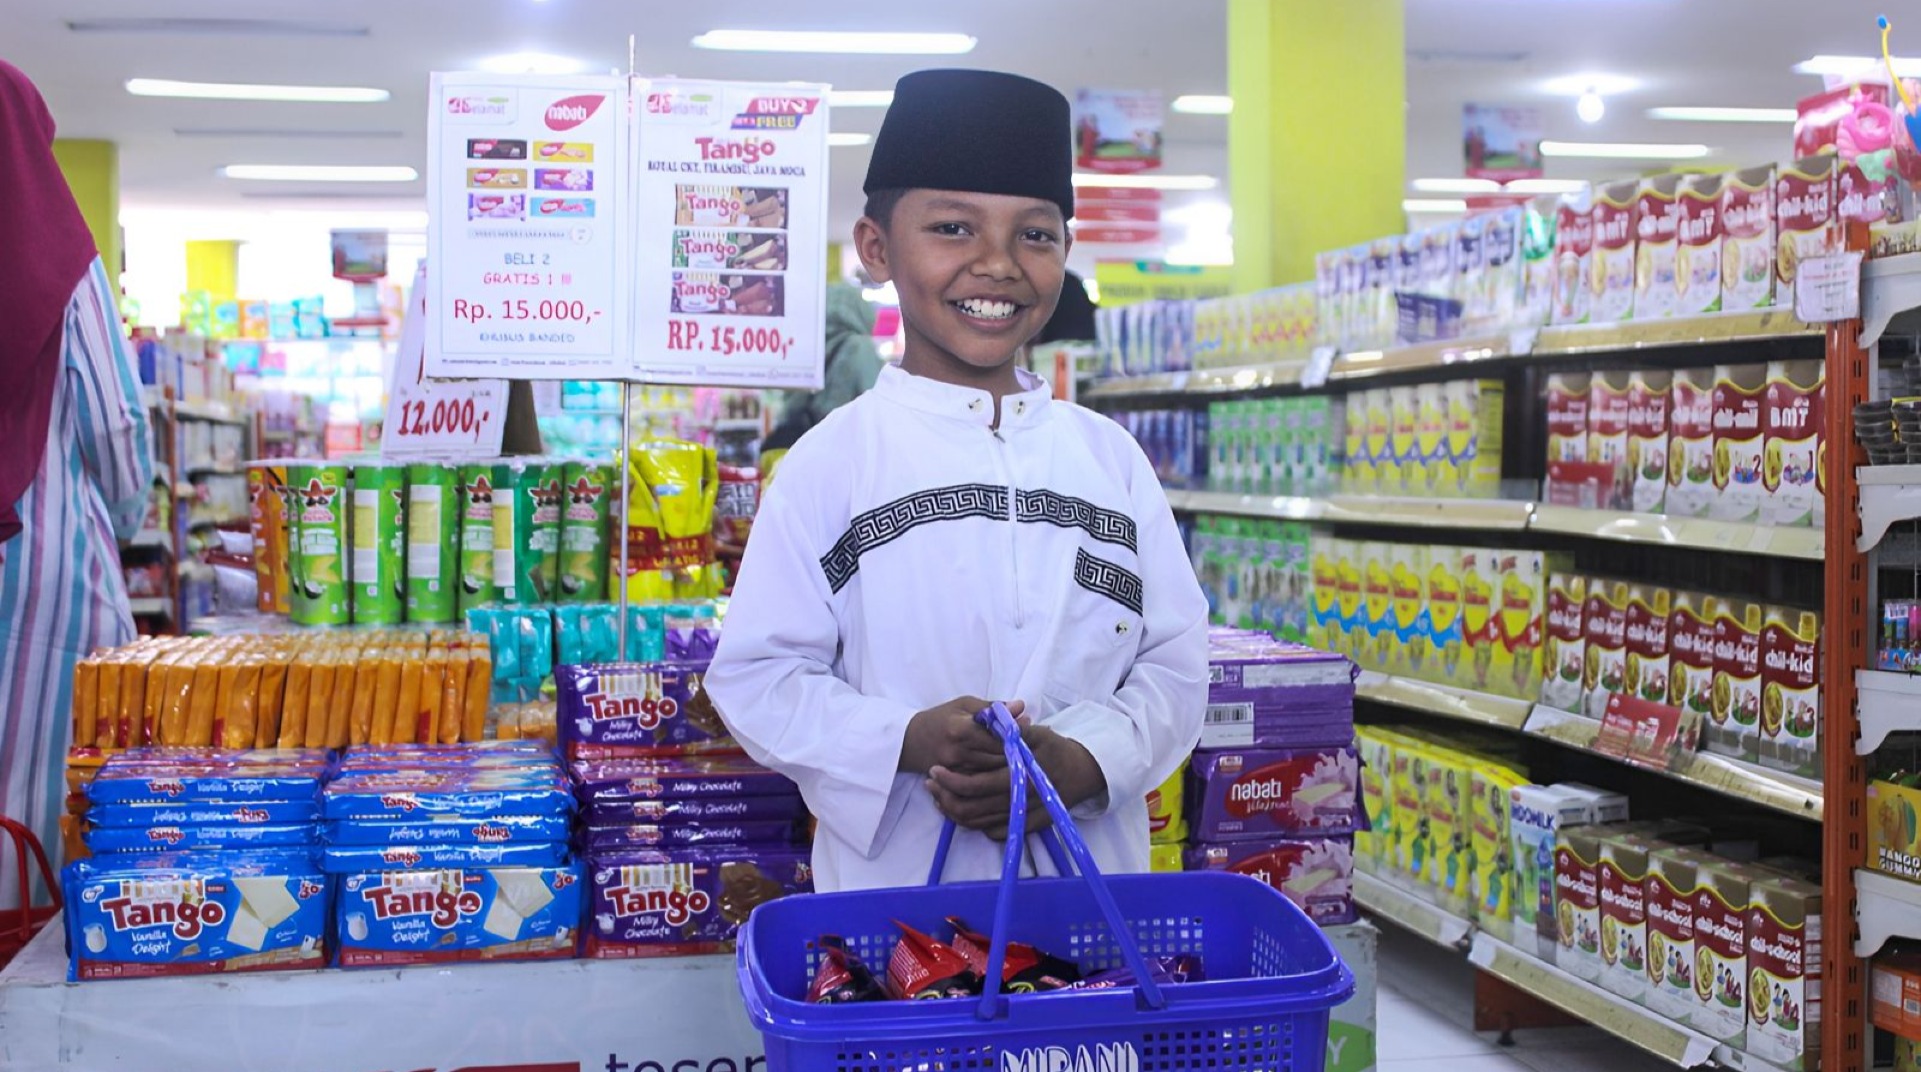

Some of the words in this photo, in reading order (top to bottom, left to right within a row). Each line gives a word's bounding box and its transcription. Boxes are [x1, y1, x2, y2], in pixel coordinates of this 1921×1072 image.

[757, 98, 790, 114] BUY
[694, 137, 777, 164] Tango
[684, 194, 742, 218] Tango
[503, 252, 535, 266] BELI
[542, 252, 551, 266] 2
[680, 239, 739, 263] Tango
[483, 271, 541, 286] GRATIS
[673, 281, 731, 304] Tango
[453, 298, 493, 325] Rp.
[501, 299, 603, 326] 15.000,-
[667, 319, 704, 352] RP.
[710, 325, 795, 361] 15.000,-
[397, 396, 490, 445] 12.000,-
[1765, 647, 1814, 674] chil-kid
[583, 694, 678, 730] Tango
[601, 727, 643, 742] Chocolate
[609, 719, 633, 732] Milky
[1230, 777, 1282, 801] nabati
[363, 885, 484, 929] Tango
[604, 887, 710, 927] Tango
[101, 897, 227, 941] Tango
[391, 917, 426, 931] Vanilla
[633, 915, 660, 928] Milky
[131, 929, 168, 942] Vanilla
[391, 927, 431, 944] Delight
[624, 924, 671, 940] Chocolate
[131, 939, 173, 957] Delight
